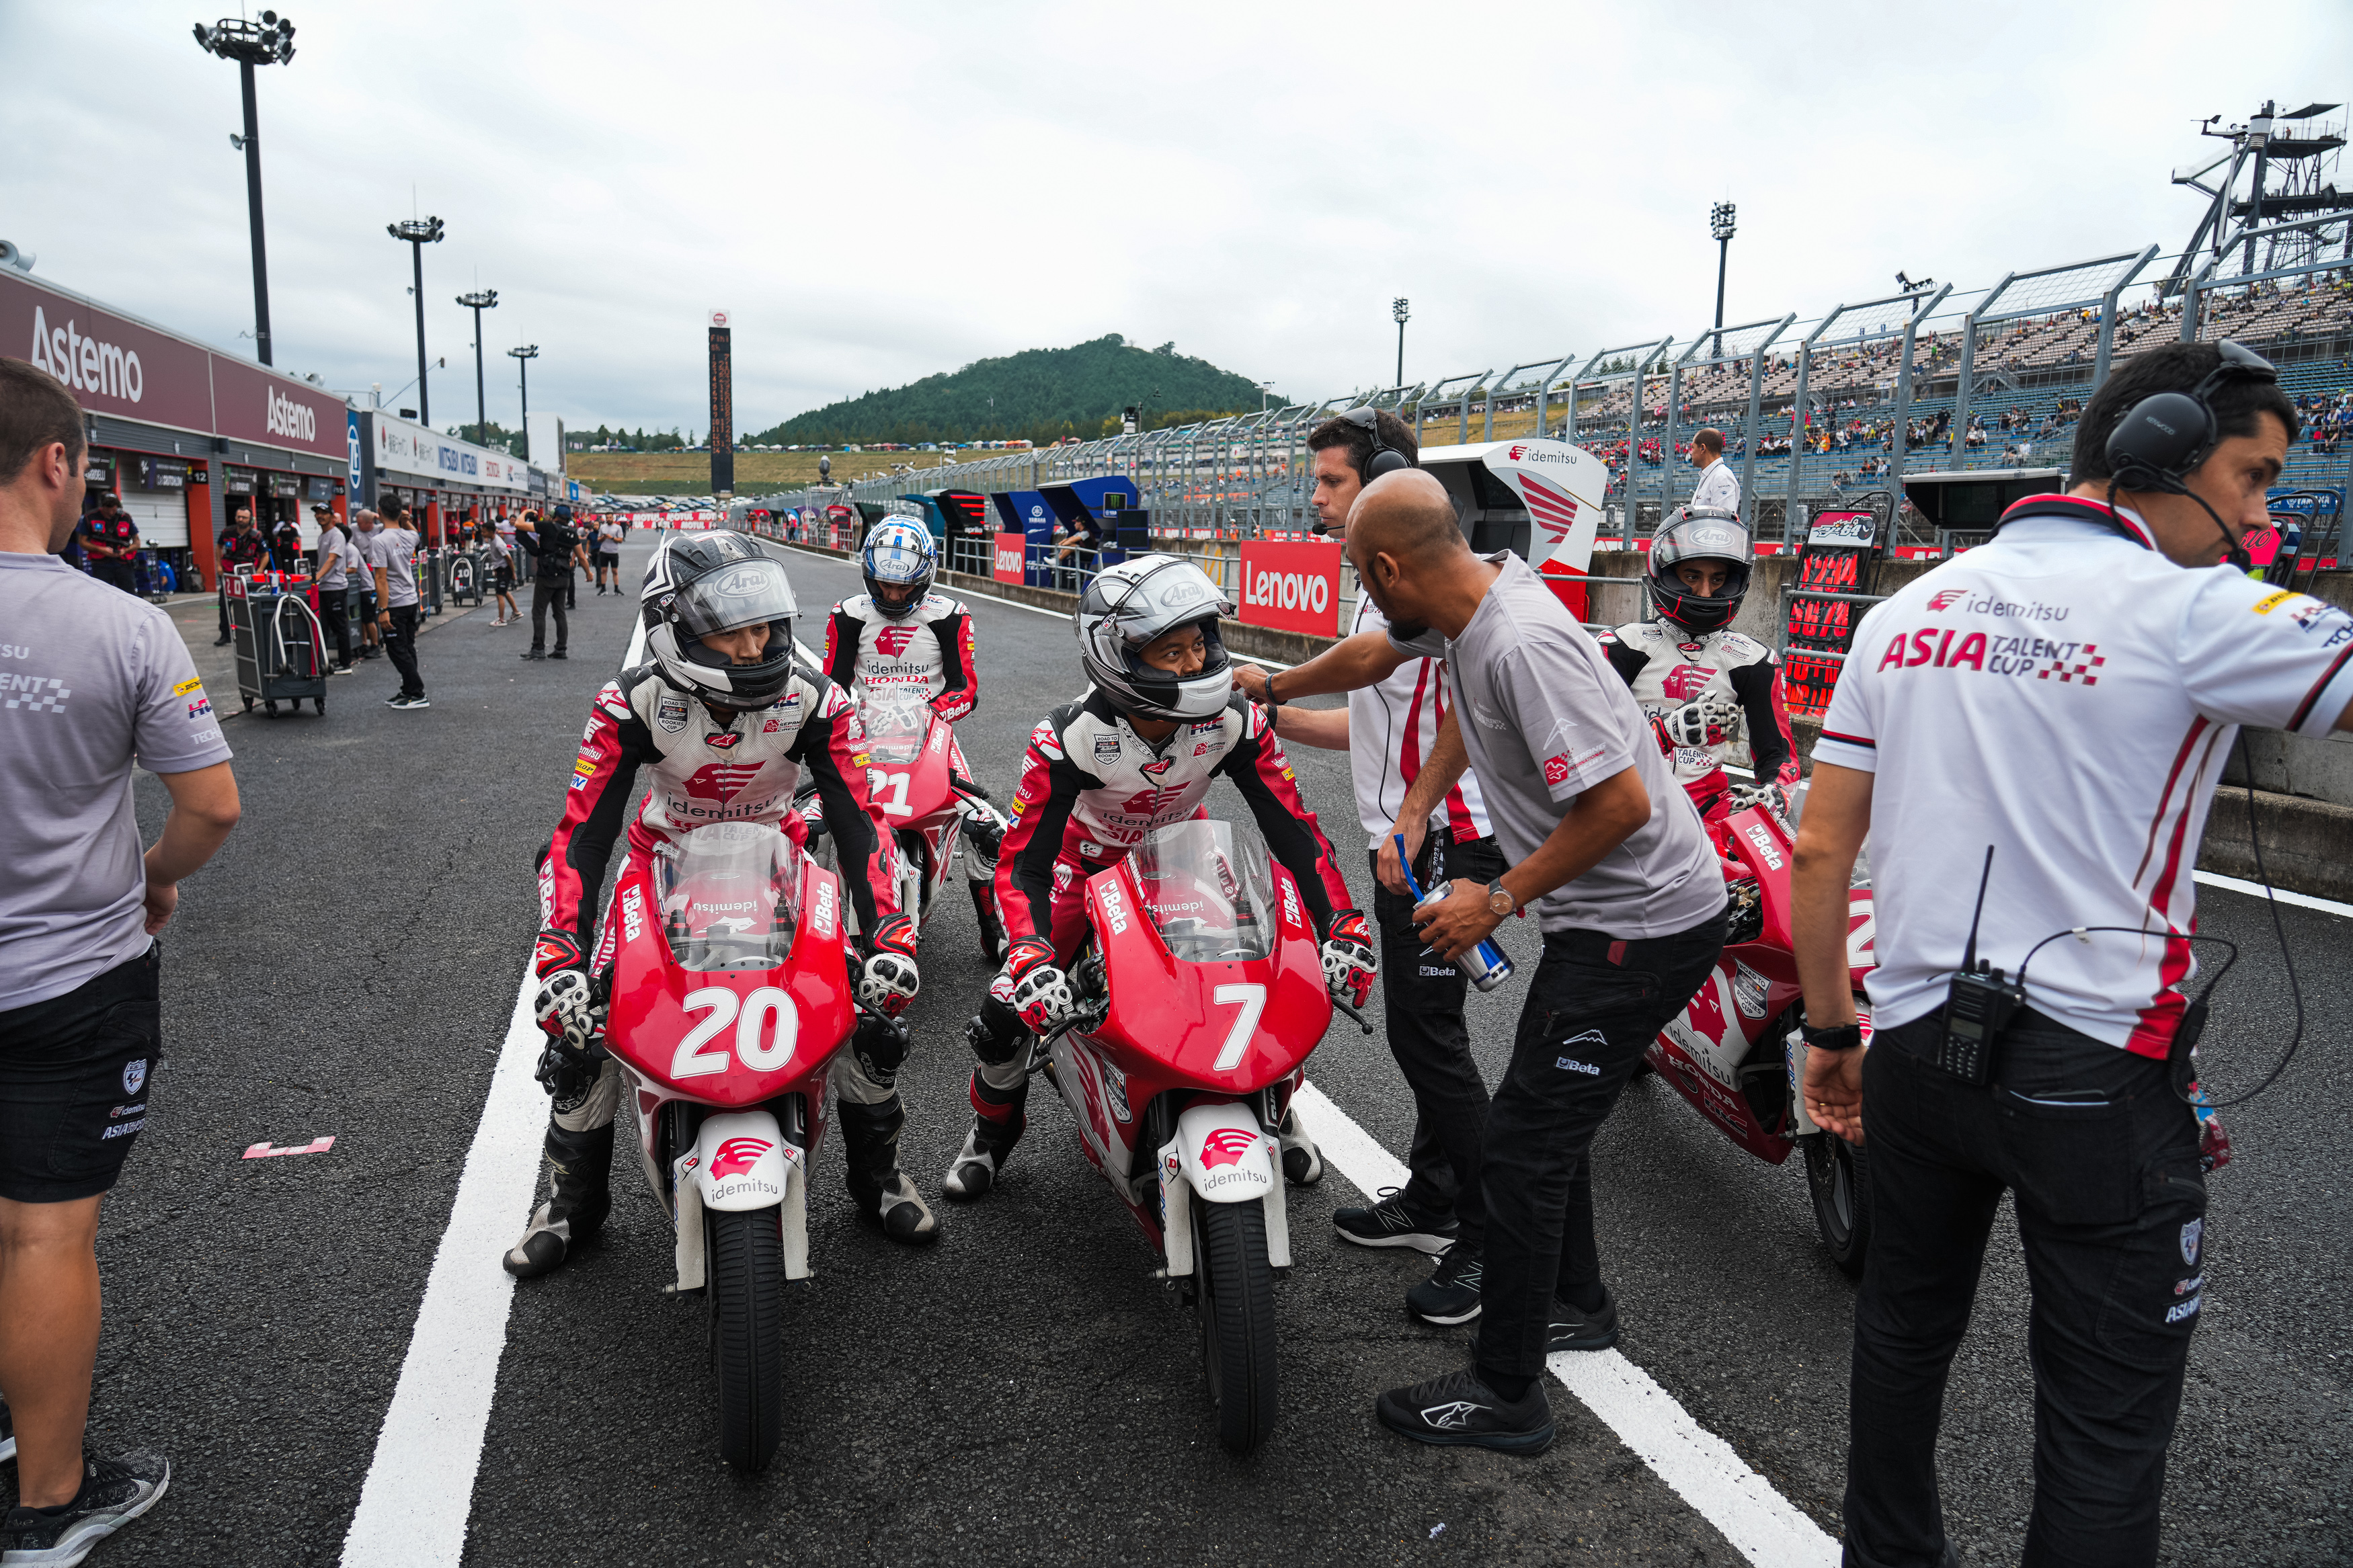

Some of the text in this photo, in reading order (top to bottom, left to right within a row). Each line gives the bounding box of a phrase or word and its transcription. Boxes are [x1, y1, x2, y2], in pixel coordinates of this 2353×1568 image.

[32, 305, 143, 403] Astemo
[268, 385, 315, 442] Astemo
[1528, 449, 1577, 464] idemitsu
[194, 472, 207, 482] 12
[1696, 530, 1730, 542] Arai
[885, 561, 907, 571] Arai
[995, 544, 1022, 573] Lenovo
[722, 571, 766, 593] Arai
[1246, 561, 1328, 614] Lenovo
[1166, 583, 1201, 605] Arai
[1966, 593, 2069, 622] idemitsu
[1105, 614, 1115, 628] R75
[1877, 628, 1987, 673] ASIA
[1991, 634, 2081, 661] TALENT
[867, 660, 929, 675] idemitsu
[1988, 656, 2034, 677] CUP
[0, 673, 47, 693] ENT
[865, 675, 929, 686] HONDA
[773, 692, 801, 708] RC
[867, 687, 896, 701] ASIA
[946, 702, 971, 719] Beta
[846, 739, 869, 753] idemi
[933, 727, 945, 747] Beta
[580, 745, 602, 760] emitsu
[1568, 742, 1607, 766] SEPANG
[1677, 749, 1704, 758] TALENT
[1677, 757, 1696, 765] CUP
[576, 760, 594, 772] NLOP
[1568, 755, 1605, 777] CIRCUIT
[667, 791, 777, 819] idemitsu
[1013, 799, 1024, 809] LOP
[1103, 808, 1193, 828] idemitsu
[1773, 811, 1797, 843] AL-SAHOU
[1752, 833, 1784, 871] Beta
[1126, 850, 1142, 887] PRATAMA
[693, 901, 758, 913] idemitsu
[817, 881, 834, 920] Beta
[1281, 876, 1299, 917] Beta
[623, 900, 643, 943] Beta
[1103, 889, 1128, 936] Beta
[1430, 966, 1455, 977] Beta
[1739, 963, 1766, 987] ROAD TO
[1736, 988, 1762, 1015] ROOKIES
[1741, 1002, 1753, 1016] CUP
[670, 987, 799, 1079] 20
[1213, 983, 1267, 1071] 7
[1669, 1021, 1732, 1086] idemitsu
[1568, 1060, 1600, 1075] Beta
[1668, 1053, 1739, 1111] HONDA
[102, 1122, 129, 1140] ASIA
[711, 1178, 779, 1203] idemitsu
[1204, 1167, 1268, 1193] idemitsu
